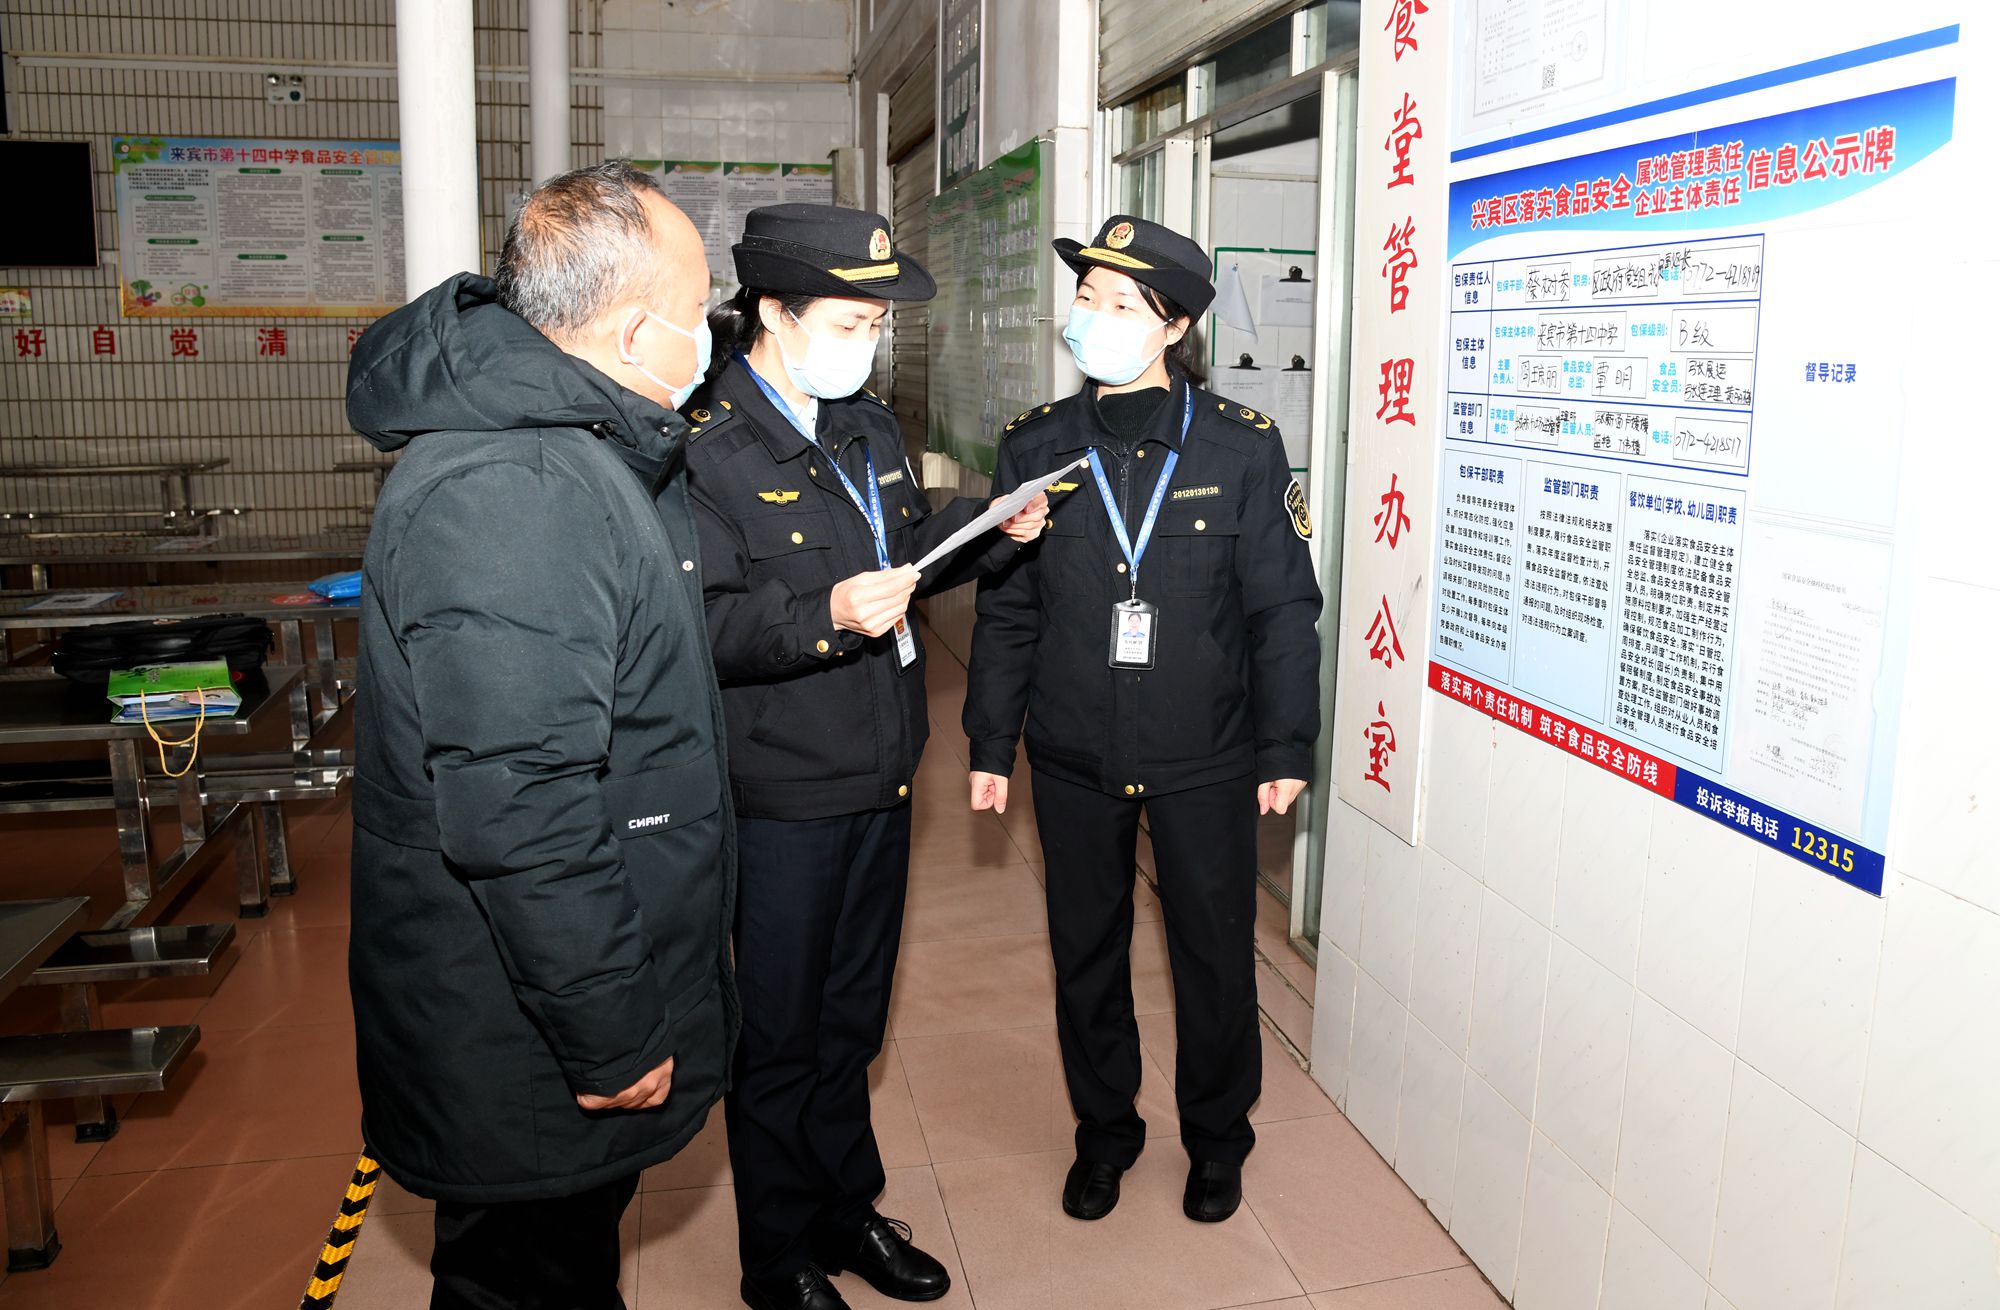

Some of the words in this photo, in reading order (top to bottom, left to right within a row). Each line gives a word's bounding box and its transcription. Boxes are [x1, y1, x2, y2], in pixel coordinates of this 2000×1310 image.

[170, 147, 401, 165] 来宾市第十四中学食品安全管理
[1636, 142, 1742, 186] 属地管理责任
[1746, 128, 1895, 190] 信息公示牌
[1472, 175, 1632, 229] 兴宾区落实食品安全
[1635, 177, 1740, 217] 企业主体责任
[1454, 270, 1491, 287] 包保责任人
[1464, 291, 1479, 304] 信息
[1630, 323, 1668, 337] 包保级别:
[1455, 338, 1485, 351] 包保主体
[1461, 356, 1476, 369] 信息
[1497, 359, 1510, 370] 主要
[1563, 360, 1592, 374] 食品安全
[1659, 362, 1677, 376] 食品
[1804, 361, 1857, 384] 督导记录
[1453, 401, 1483, 417] 监管部门
[1490, 408, 1515, 421] 日常监管
[1460, 420, 1474, 434] 信息
[1459, 464, 1505, 484] 包保干部职责
[1172, 486, 1219, 499] 20120130130
[1543, 476, 1600, 502] 监管部门职责
[1440, 671, 1533, 729] 落实两个责任机制
[1540, 714, 1659, 787] 筑牢食品安全防线
[1696, 786, 1779, 842] 投诉举报电话
[1790, 825, 1855, 873] 12315
